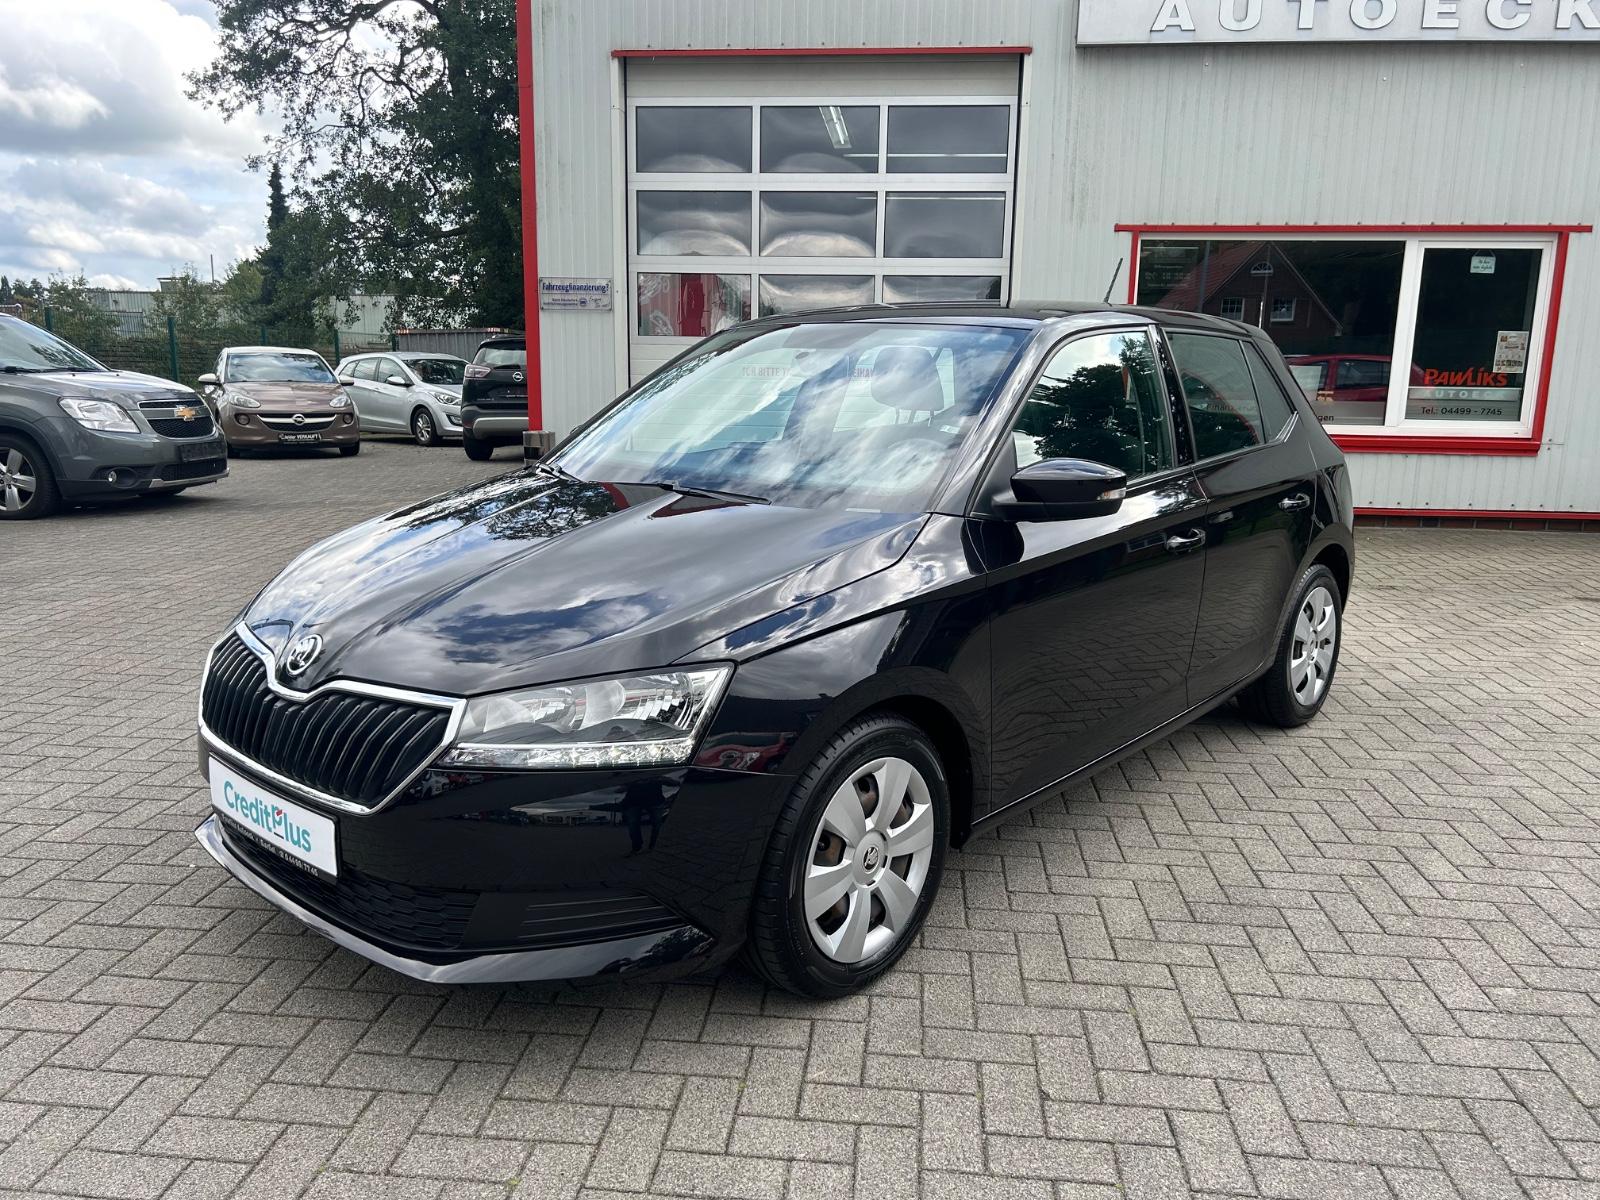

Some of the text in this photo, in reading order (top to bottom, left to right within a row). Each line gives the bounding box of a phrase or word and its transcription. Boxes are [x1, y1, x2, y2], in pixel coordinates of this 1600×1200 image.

[1150, 0, 1600, 32] AUTOECK
[542, 282, 610, 294] Fahrzeugfinanzierung?
[1440, 407, 1472, 415] 04499
[1480, 407, 1503, 416] 7745
[1316, 415, 1335, 423] gen
[224, 780, 312, 853] CreditPlus
